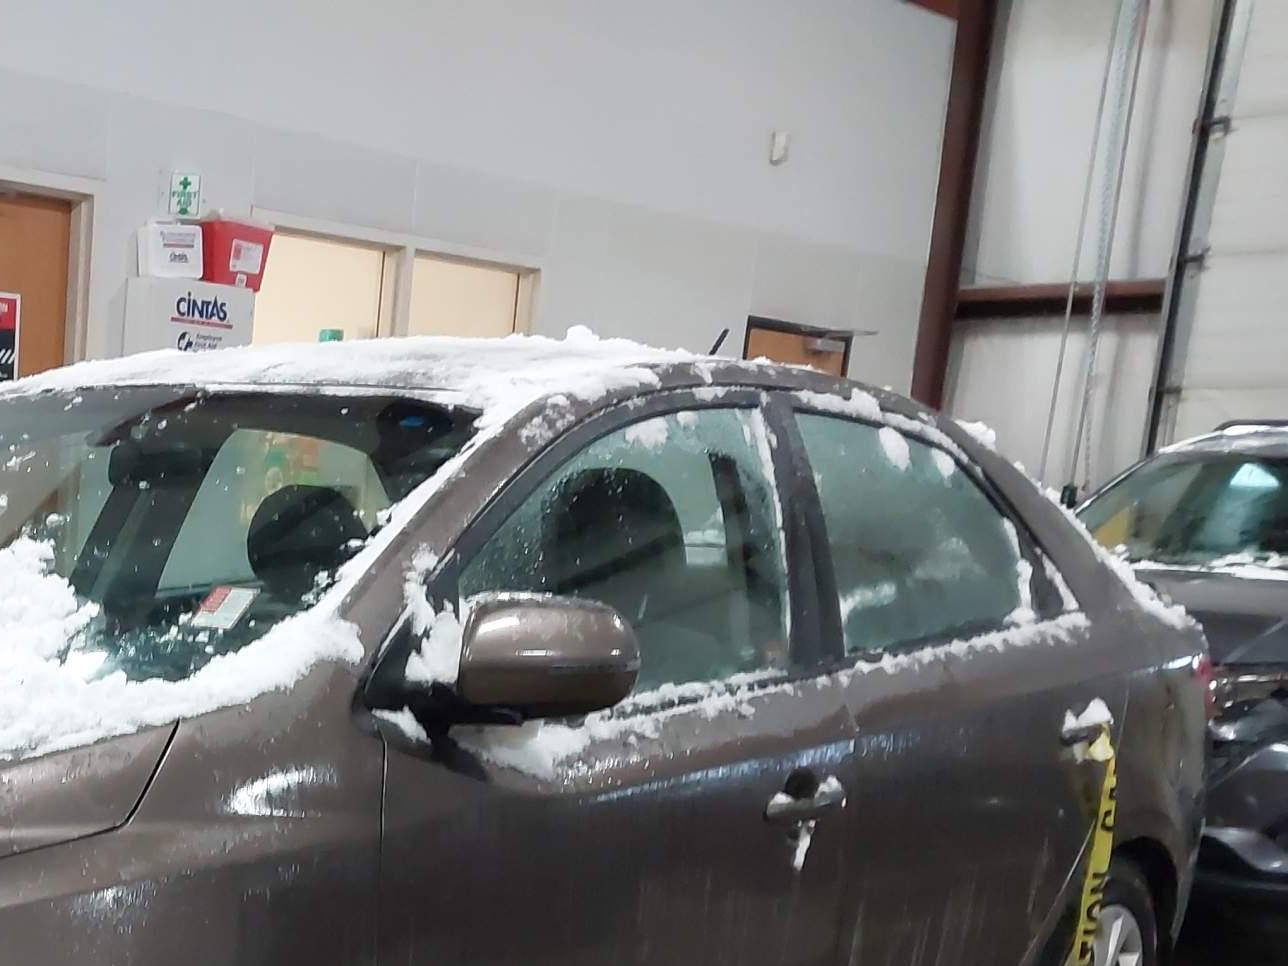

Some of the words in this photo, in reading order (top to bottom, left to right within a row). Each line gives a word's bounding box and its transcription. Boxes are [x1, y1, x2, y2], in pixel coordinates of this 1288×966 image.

[172, 190, 197, 200] FIRST
[176, 199, 192, 208] AID
[176, 291, 228, 322] CINTAS
